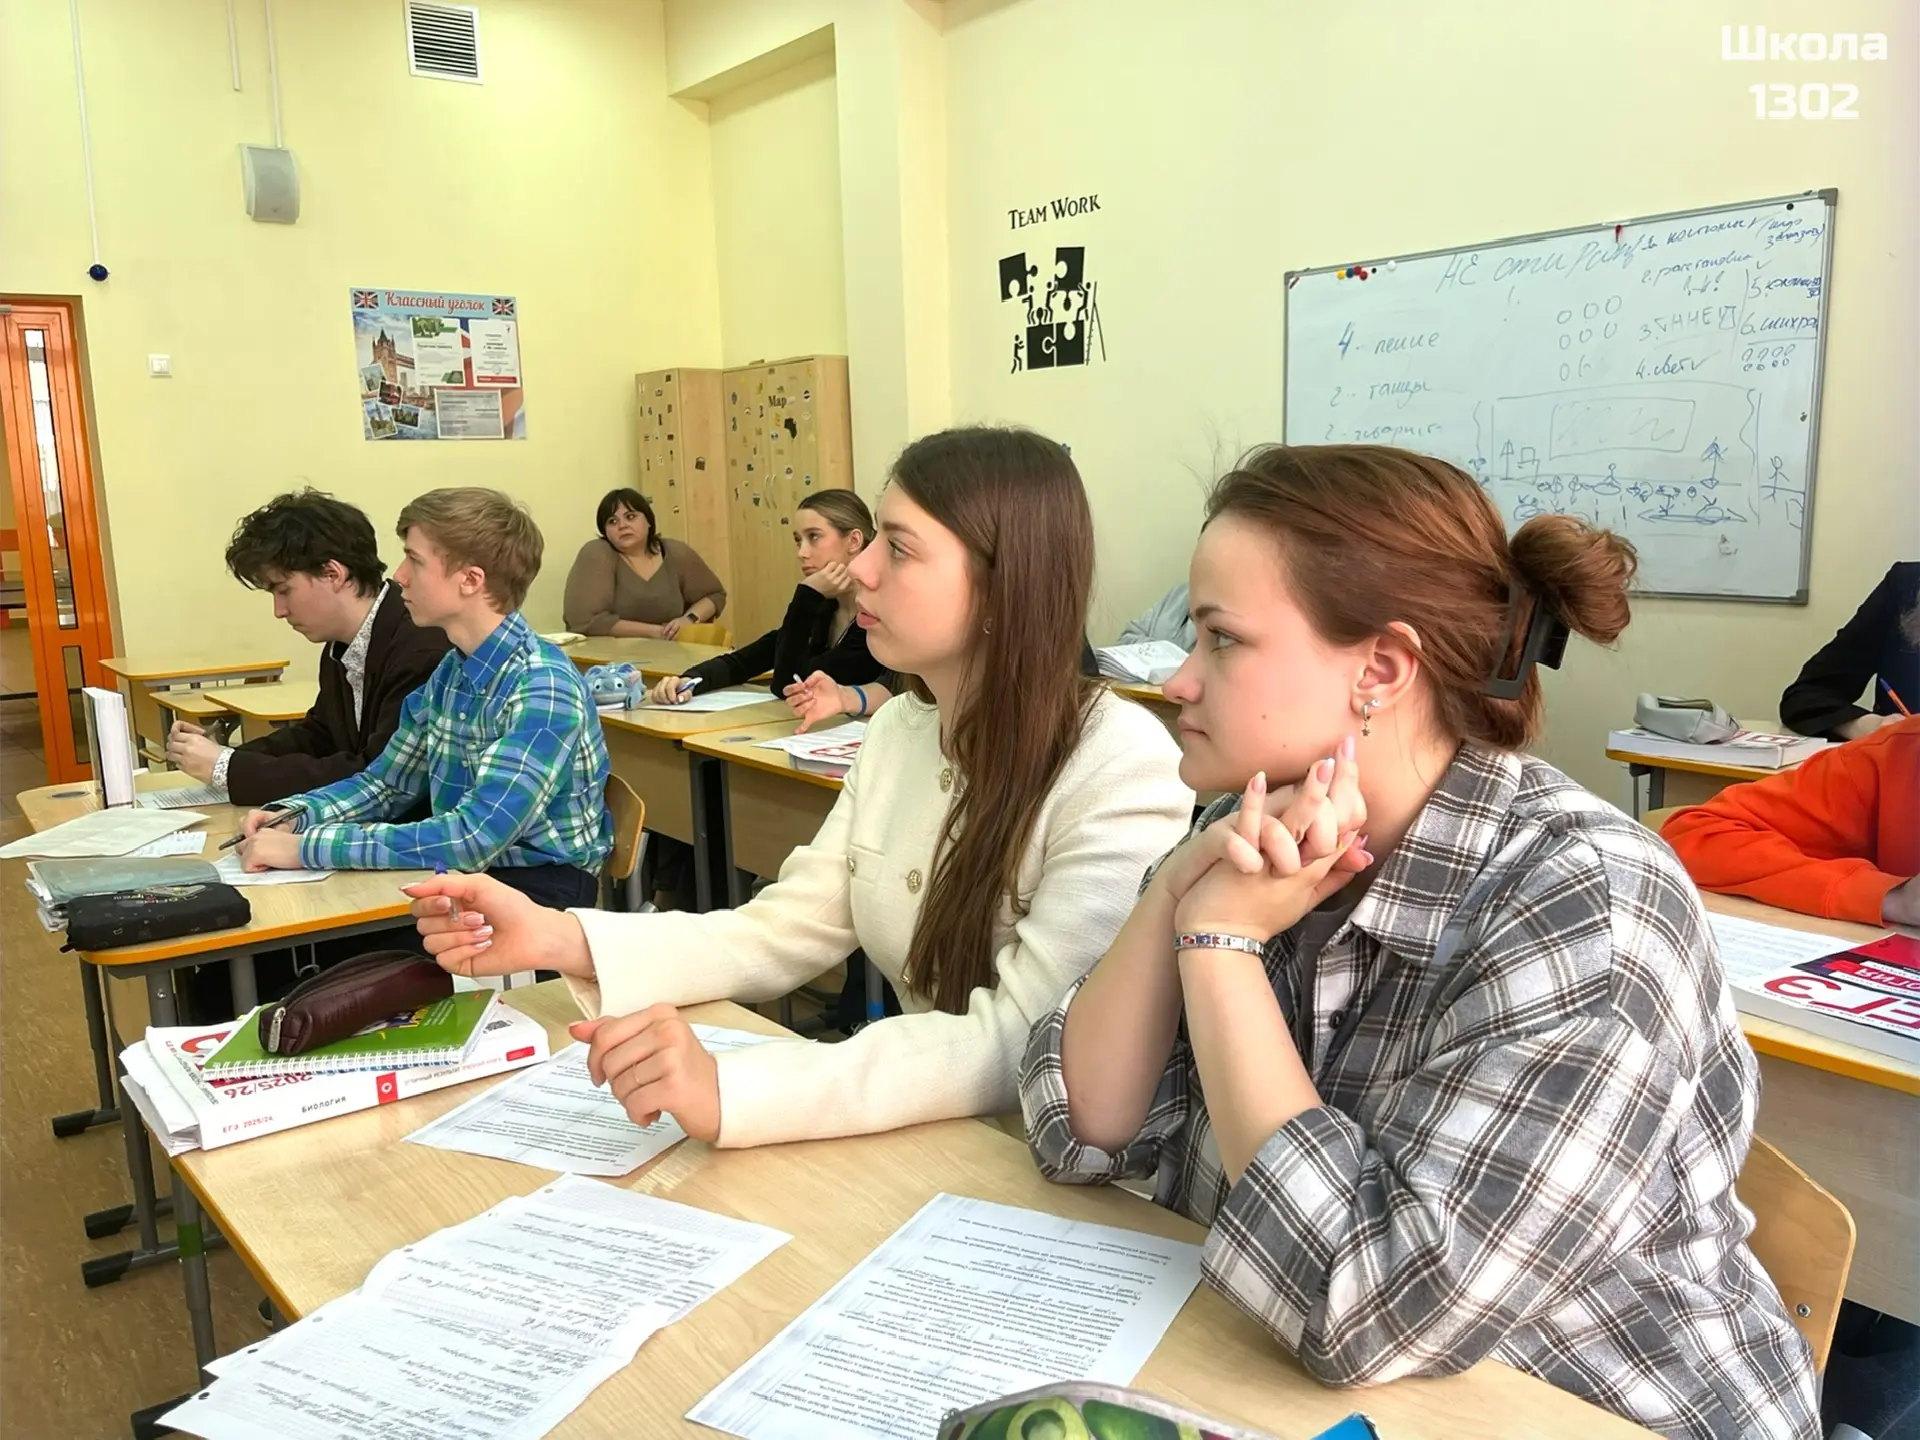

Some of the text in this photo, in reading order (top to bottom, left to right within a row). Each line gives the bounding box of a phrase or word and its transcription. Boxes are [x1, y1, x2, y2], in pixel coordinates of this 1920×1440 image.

[384, 291, 485, 314] Классный уголок
[768, 395, 787, 409] Map
[1369, 381, 1432, 410] танцы
[301, 1096, 347, 1113] БИОЛОГИЯ
